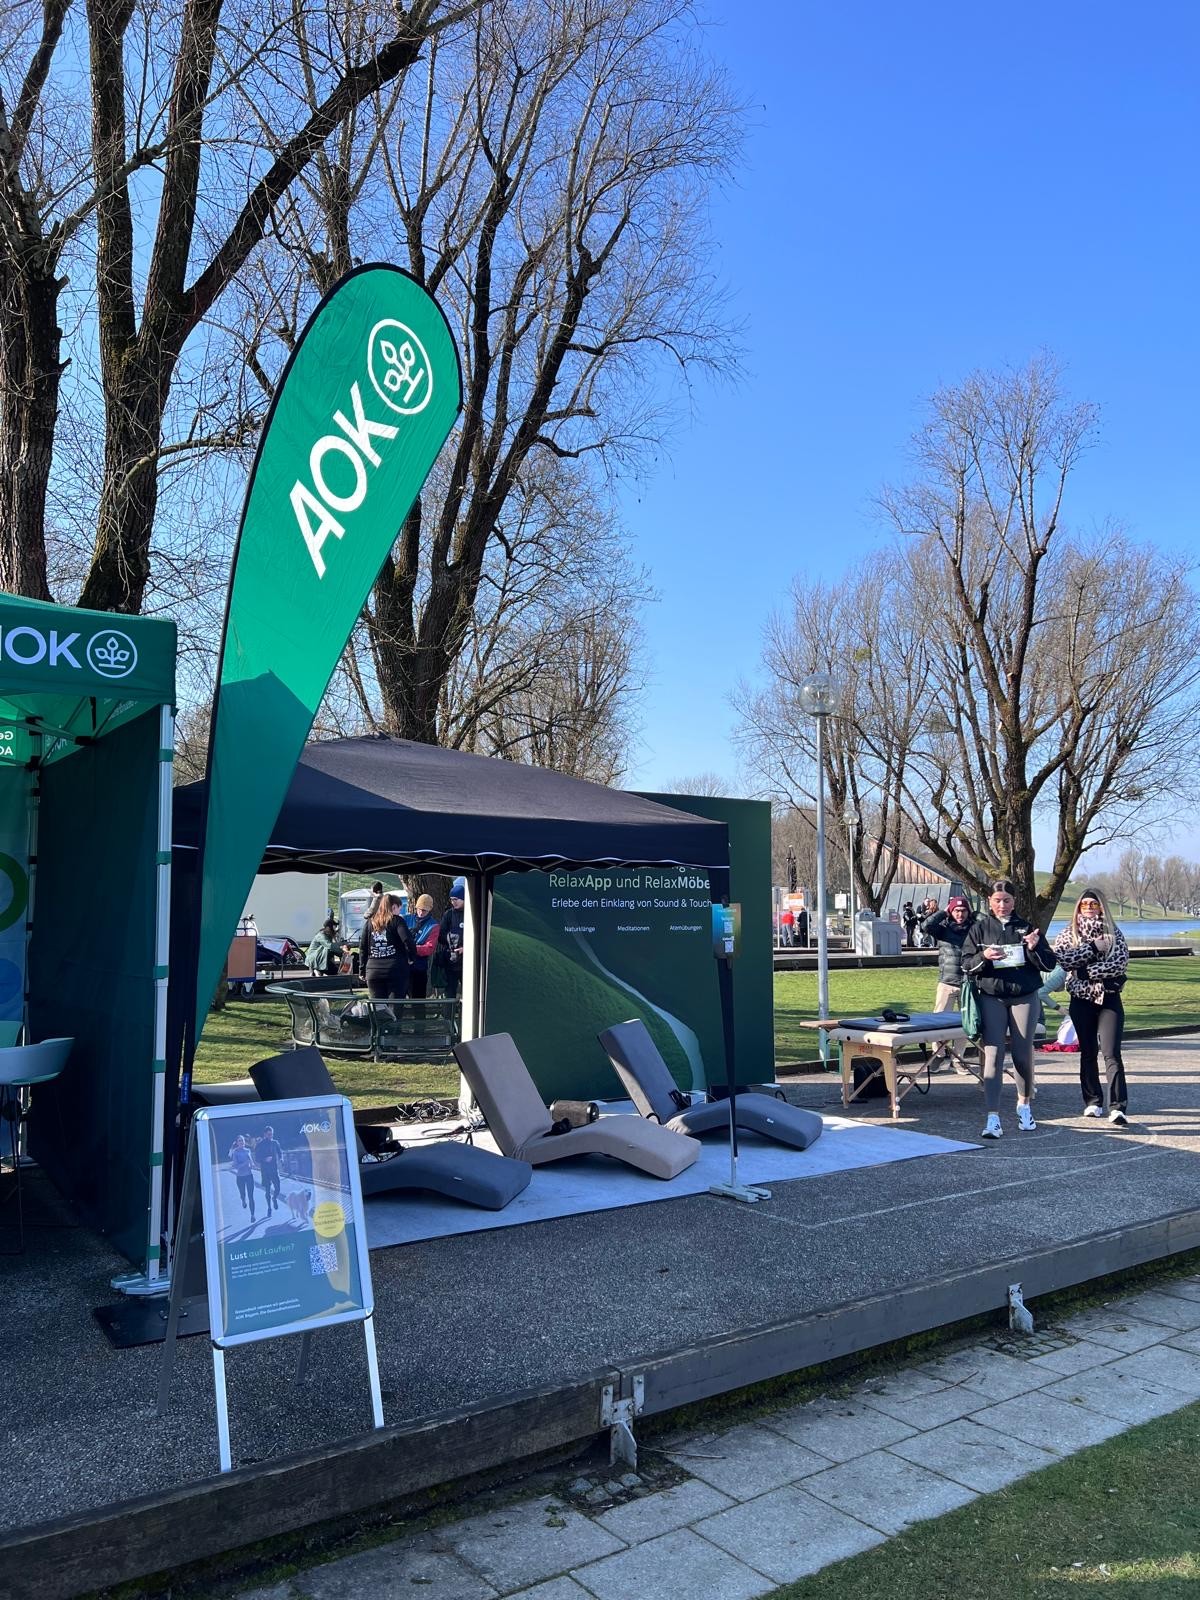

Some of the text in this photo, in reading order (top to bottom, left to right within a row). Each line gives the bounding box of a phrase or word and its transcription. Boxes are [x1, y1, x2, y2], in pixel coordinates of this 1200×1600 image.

[289, 380, 399, 580] AOK
[0, 625, 82, 668] OK
[549, 873, 711, 891] RelaxApp und RelaxMöbe
[551, 898, 712, 909] Erlebe den Einklang von Sound & Touch
[299, 1122, 320, 1134] AOK
[230, 1251, 248, 1261] Lust
[248, 1249, 262, 1257] auf
